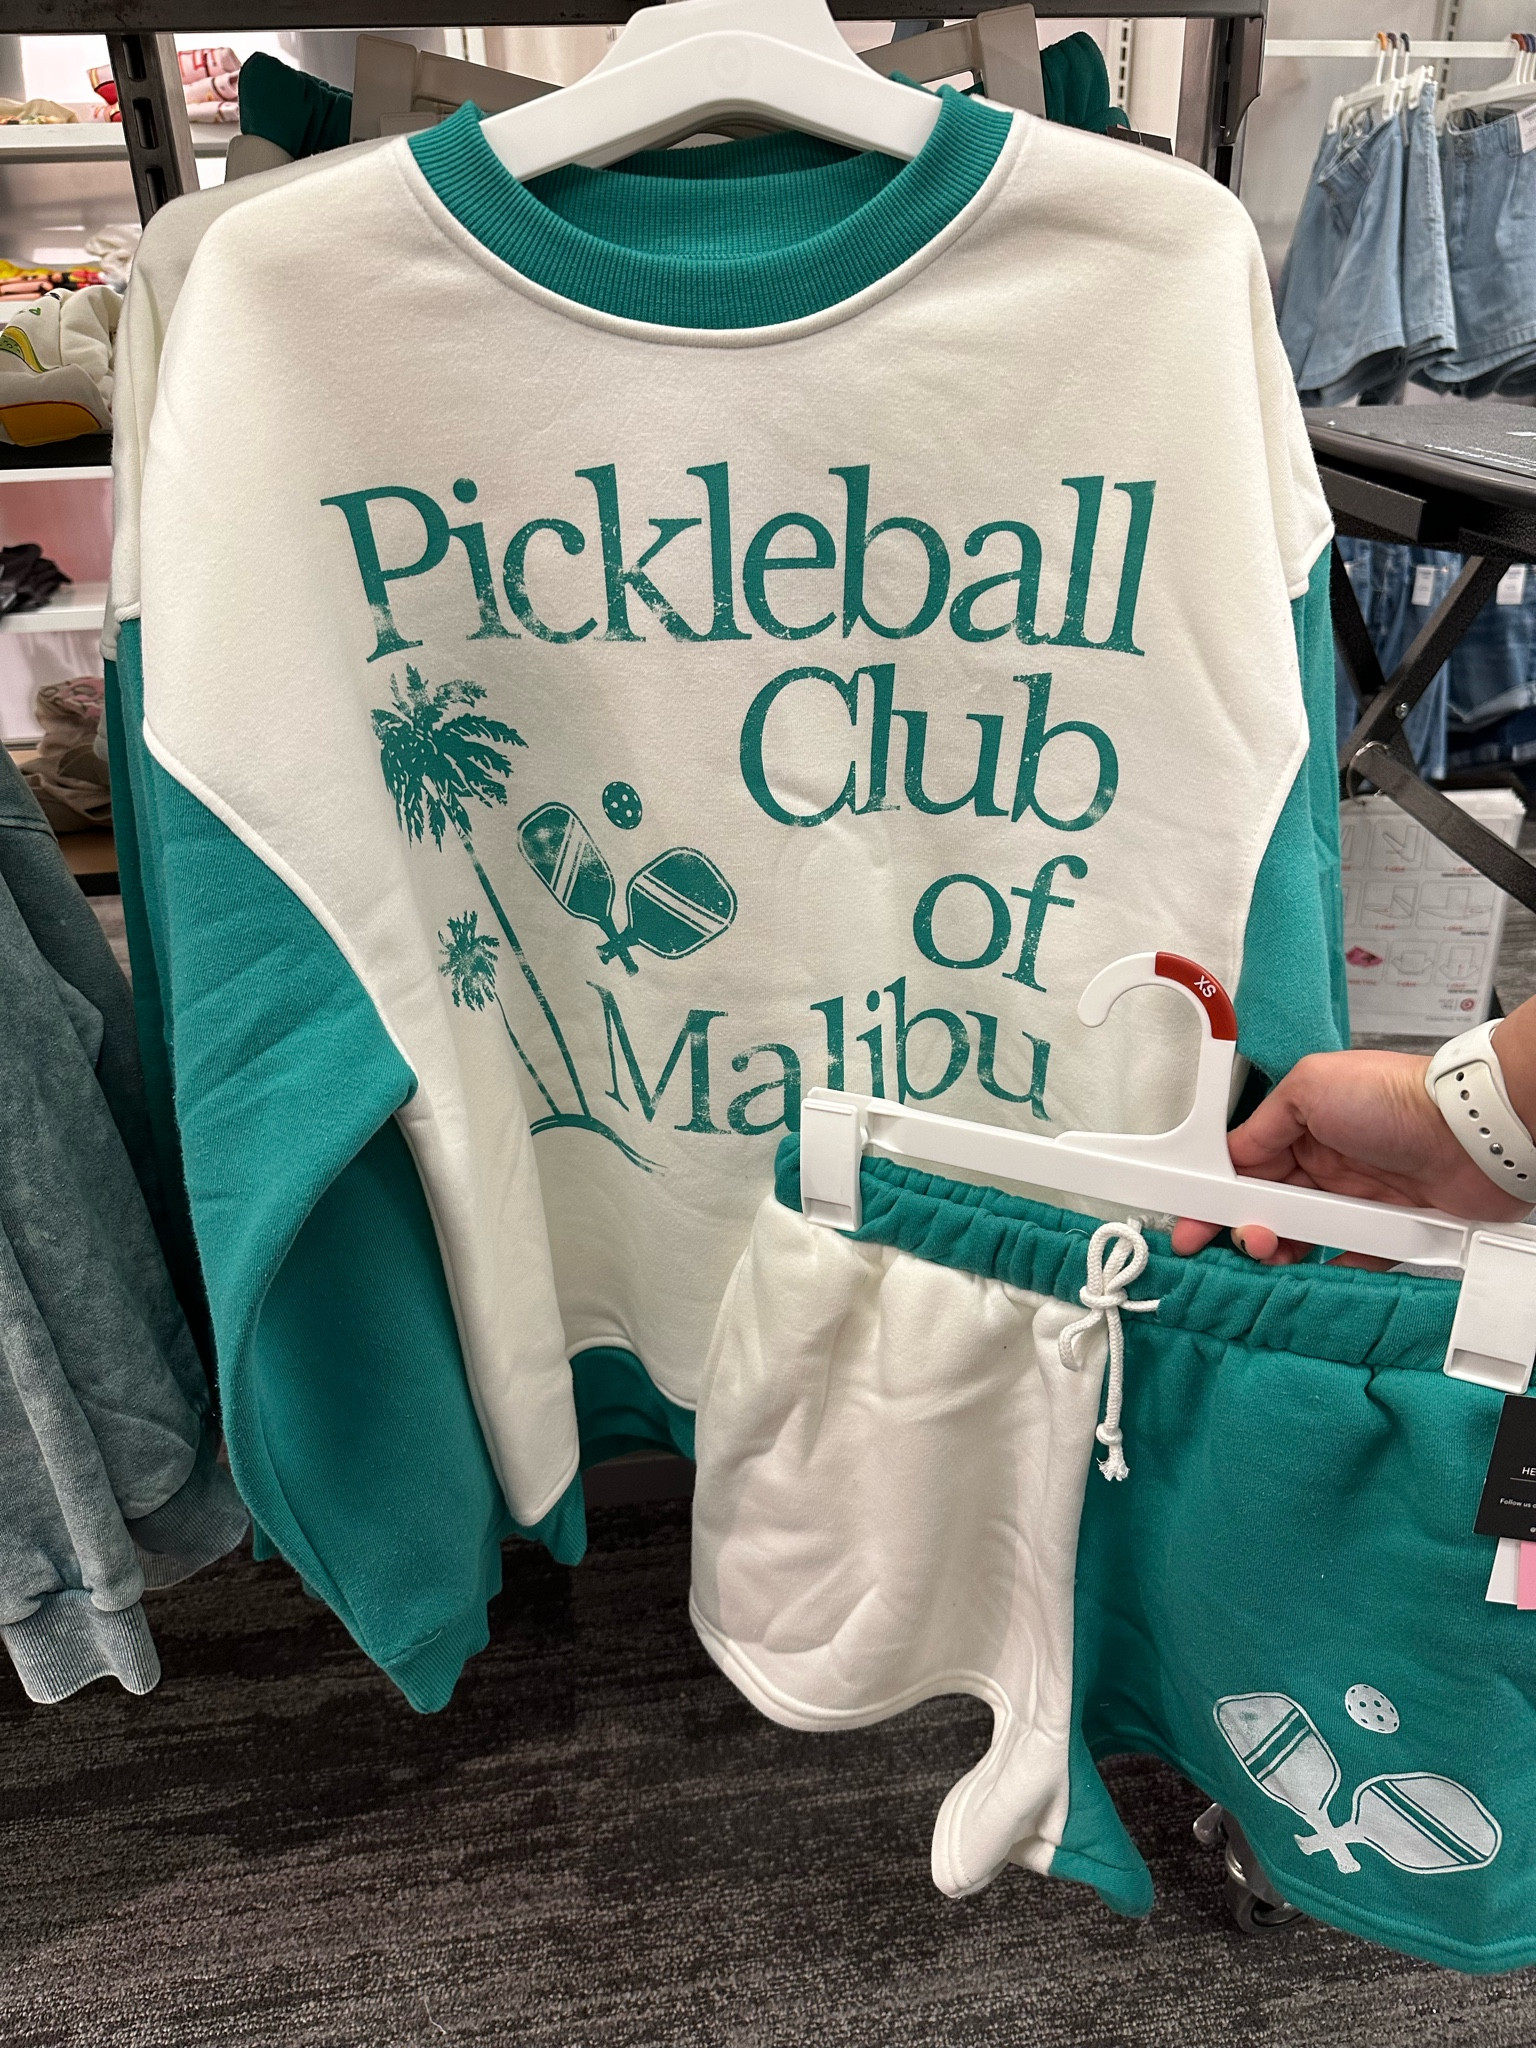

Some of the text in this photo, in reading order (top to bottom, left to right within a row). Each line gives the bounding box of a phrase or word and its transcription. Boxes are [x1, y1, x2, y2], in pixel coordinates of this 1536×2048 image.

[320, 461, 1158, 663] Pickleball
[739, 663, 1120, 832] Club
[912, 853, 1089, 993] of
[1193, 975, 1217, 998] XS
[584, 975, 1053, 1136] Malibu
[1499, 1497, 1523, 1507] Follow
